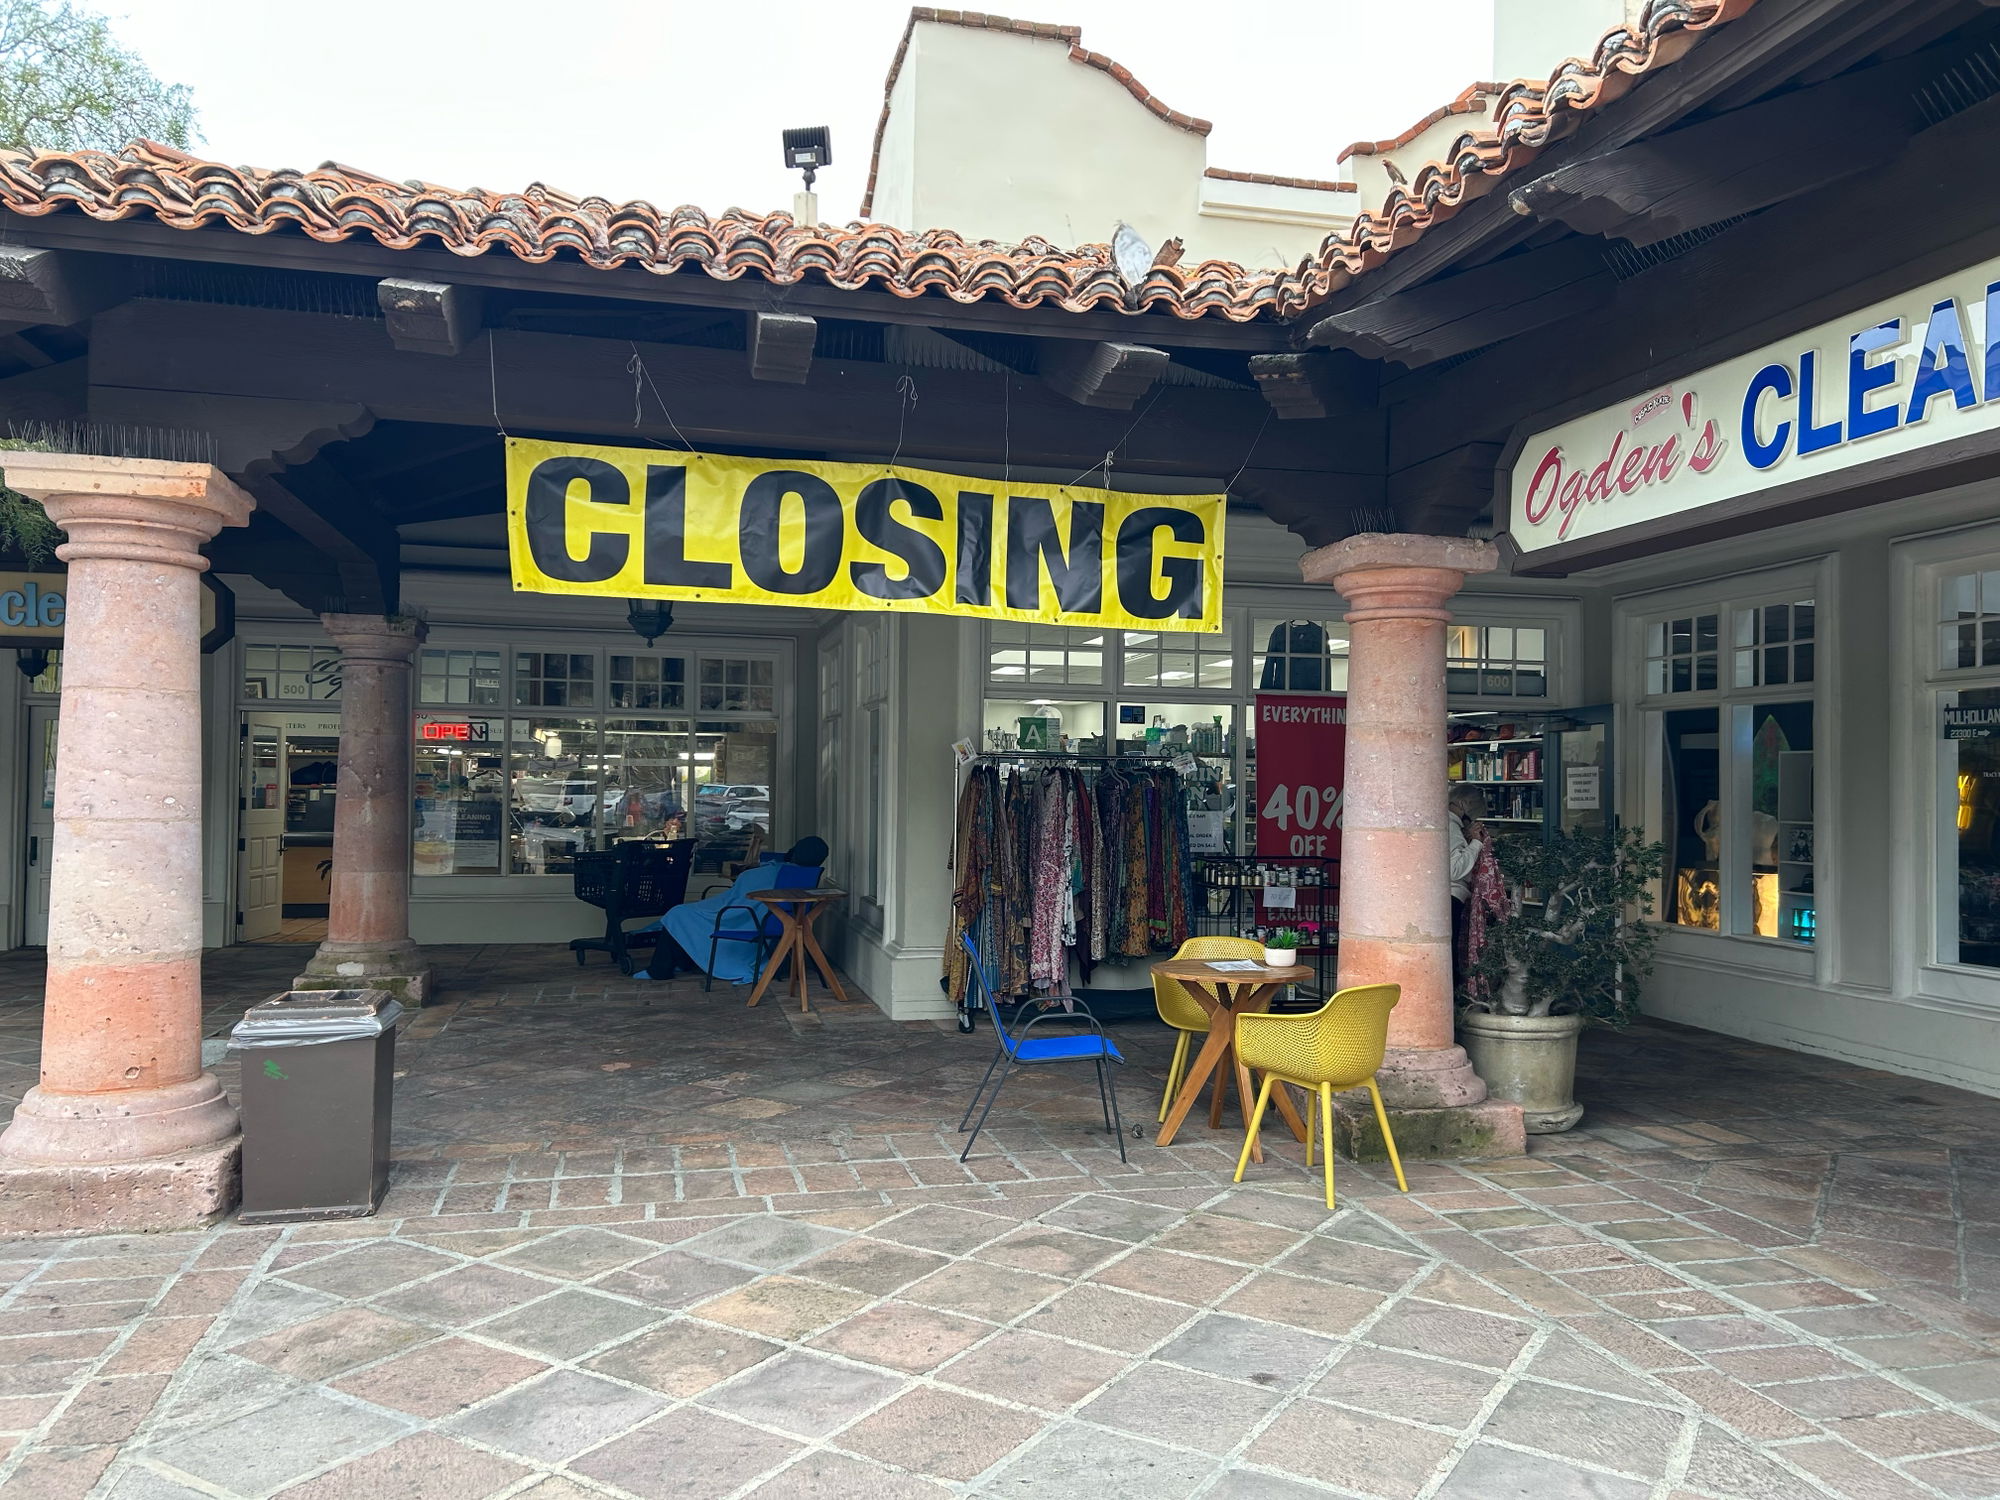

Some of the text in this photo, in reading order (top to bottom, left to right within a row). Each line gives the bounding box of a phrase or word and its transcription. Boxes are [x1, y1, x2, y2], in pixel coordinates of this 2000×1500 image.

[1525, 391, 1722, 541] Ogden's
[525, 456, 1206, 620] CLOSING
[283, 684, 305, 695] 500
[1486, 675, 1509, 688] 600
[1262, 704, 1346, 725] EVERYTHIN
[422, 722, 484, 741] OPEN
[1024, 724, 1041, 743] A
[1261, 783, 1344, 832] 40%
[1290, 835, 1328, 857] OFF
